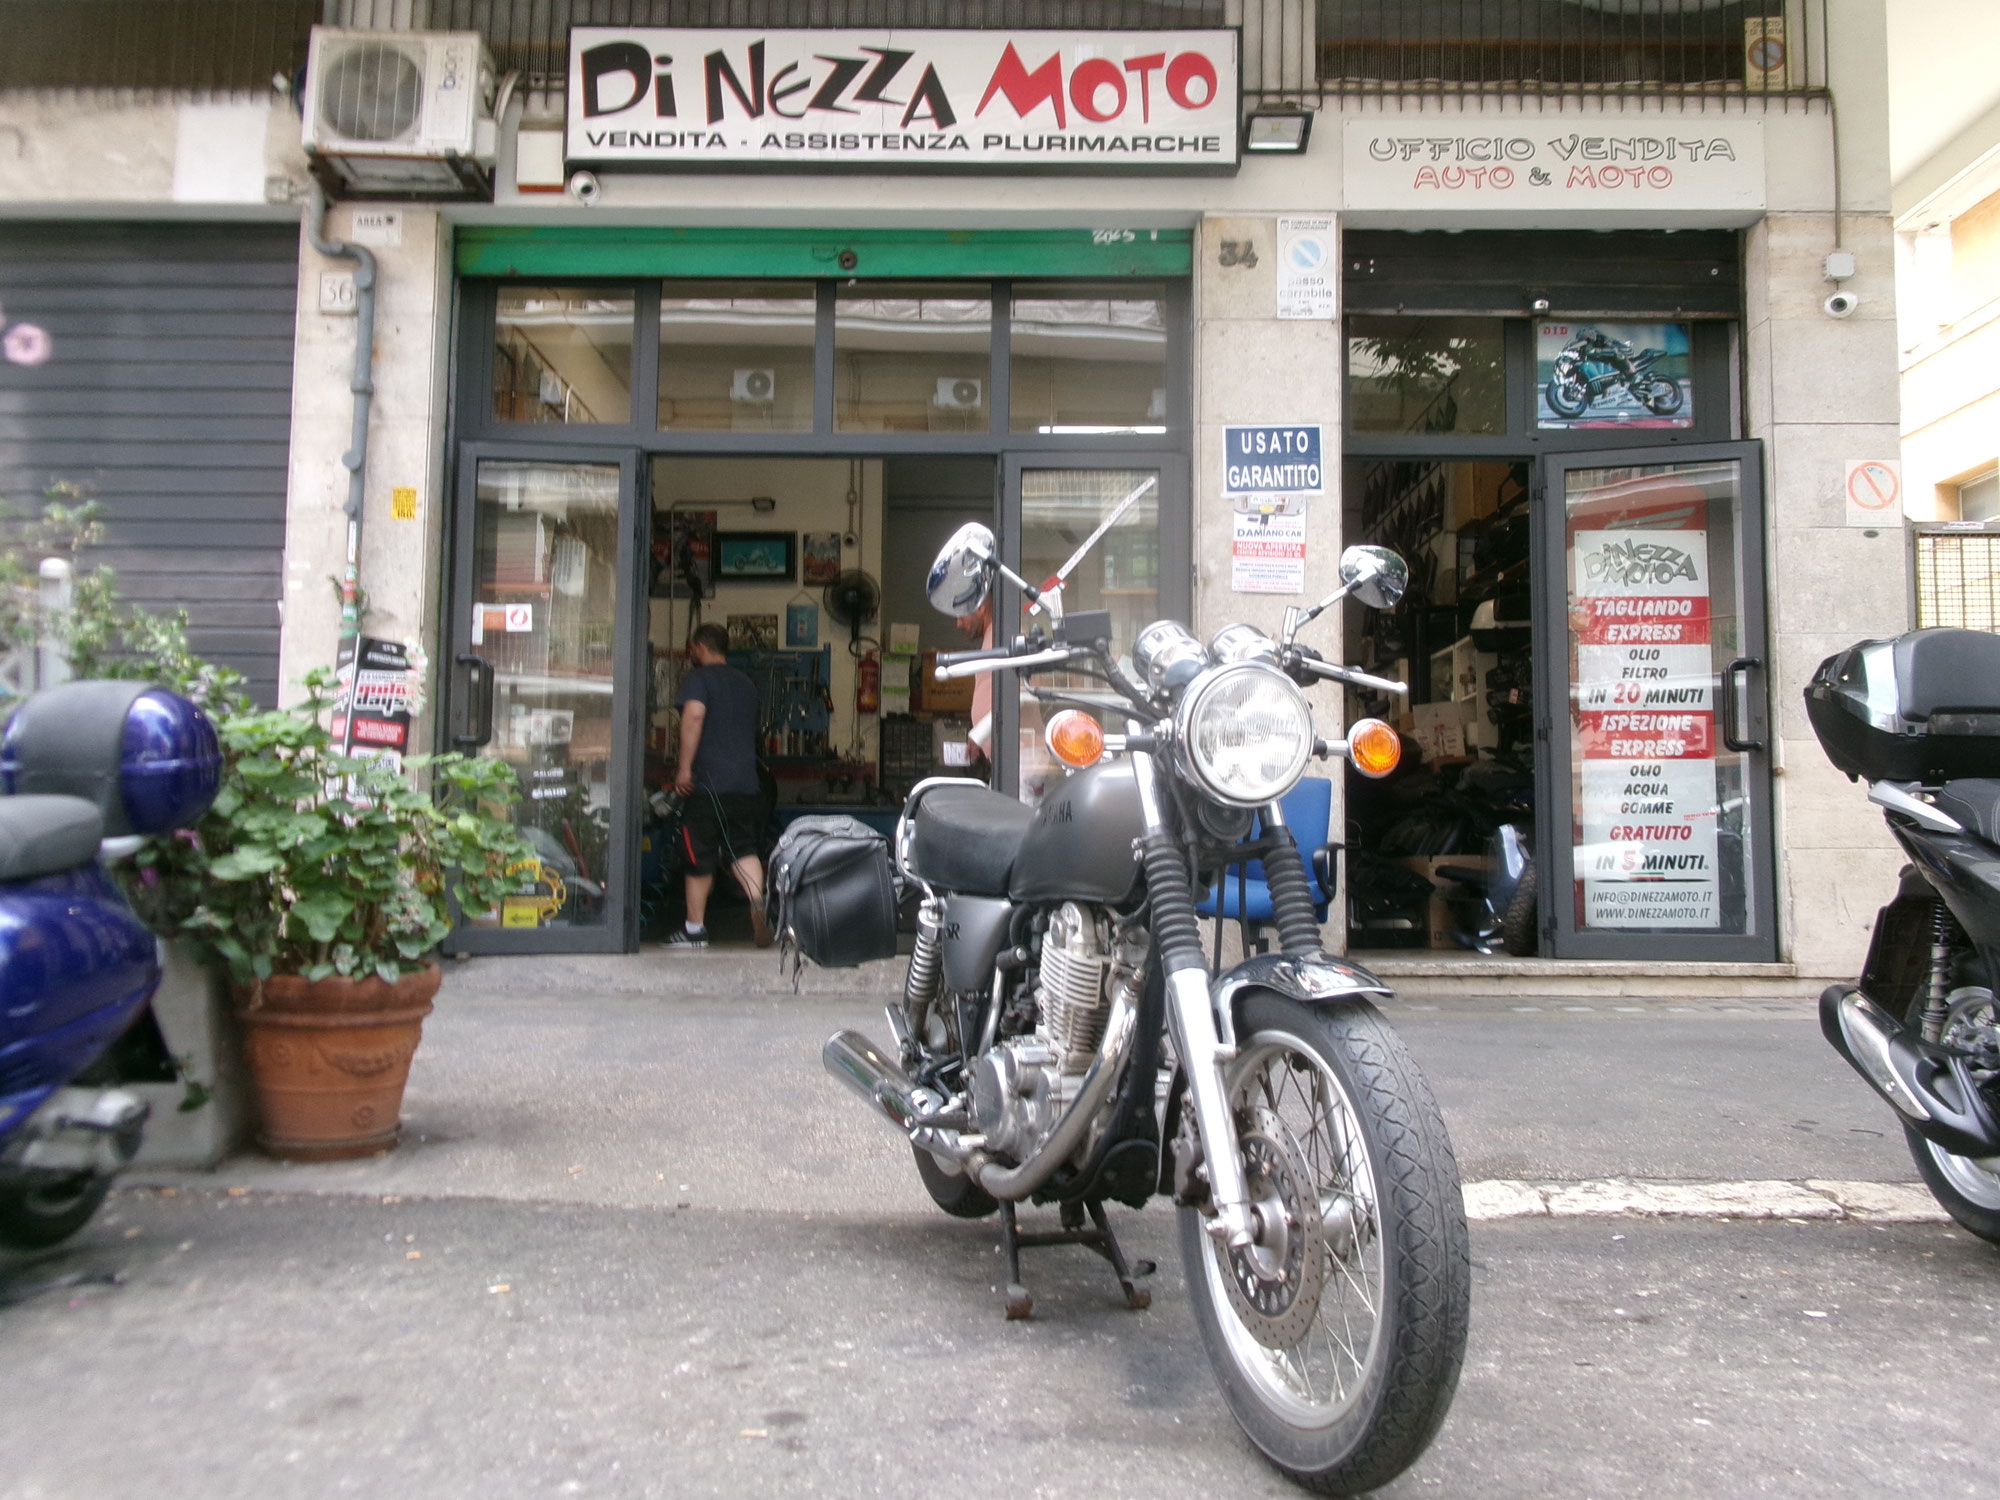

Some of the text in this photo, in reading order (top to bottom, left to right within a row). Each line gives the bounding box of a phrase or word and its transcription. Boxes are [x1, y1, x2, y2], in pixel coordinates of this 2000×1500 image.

[974, 40, 1217, 130] MOTO
[586, 131, 727, 149] VENDITA
[761, 132, 970, 151] ASSISTENZA
[983, 134, 1220, 152] PLURIMARCHE
[1369, 134, 1736, 162] UFFICIO VENDITA
[1414, 166, 1673, 189] AUTO & MOTO
[324, 278, 354, 305] 36
[1280, 287, 1332, 298] carrabile
[1241, 431, 1309, 454] USATO
[1228, 464, 1320, 488] GARANTITO
[1237, 528, 1284, 538] DAMIANO
[1595, 600, 1692, 616] TAGLIANDO
[1607, 624, 1682, 641] EXPRESS
[1629, 649, 1660, 660] OLIO
[1622, 667, 1667, 679] FILTRO
[1588, 683, 1704, 704] IN 20 MINUTI
[1601, 715, 1693, 732] ISPEZIONE
[1610, 739, 1686, 756] EXPRESS
[1630, 765, 1661, 777] OLIO
[1624, 783, 1668, 796] ACQUA
[1621, 802, 1674, 814] GOMME
[1610, 825, 1692, 841] GRATUITO
[1595, 855, 1615, 870] IN
[1622, 851, 1636, 870] 5
[1592, 891, 1713, 904] INFO@DINEZZAMOTO.IT
[1596, 908, 1710, 919] WWW.DINEZZAMOTO.IT
